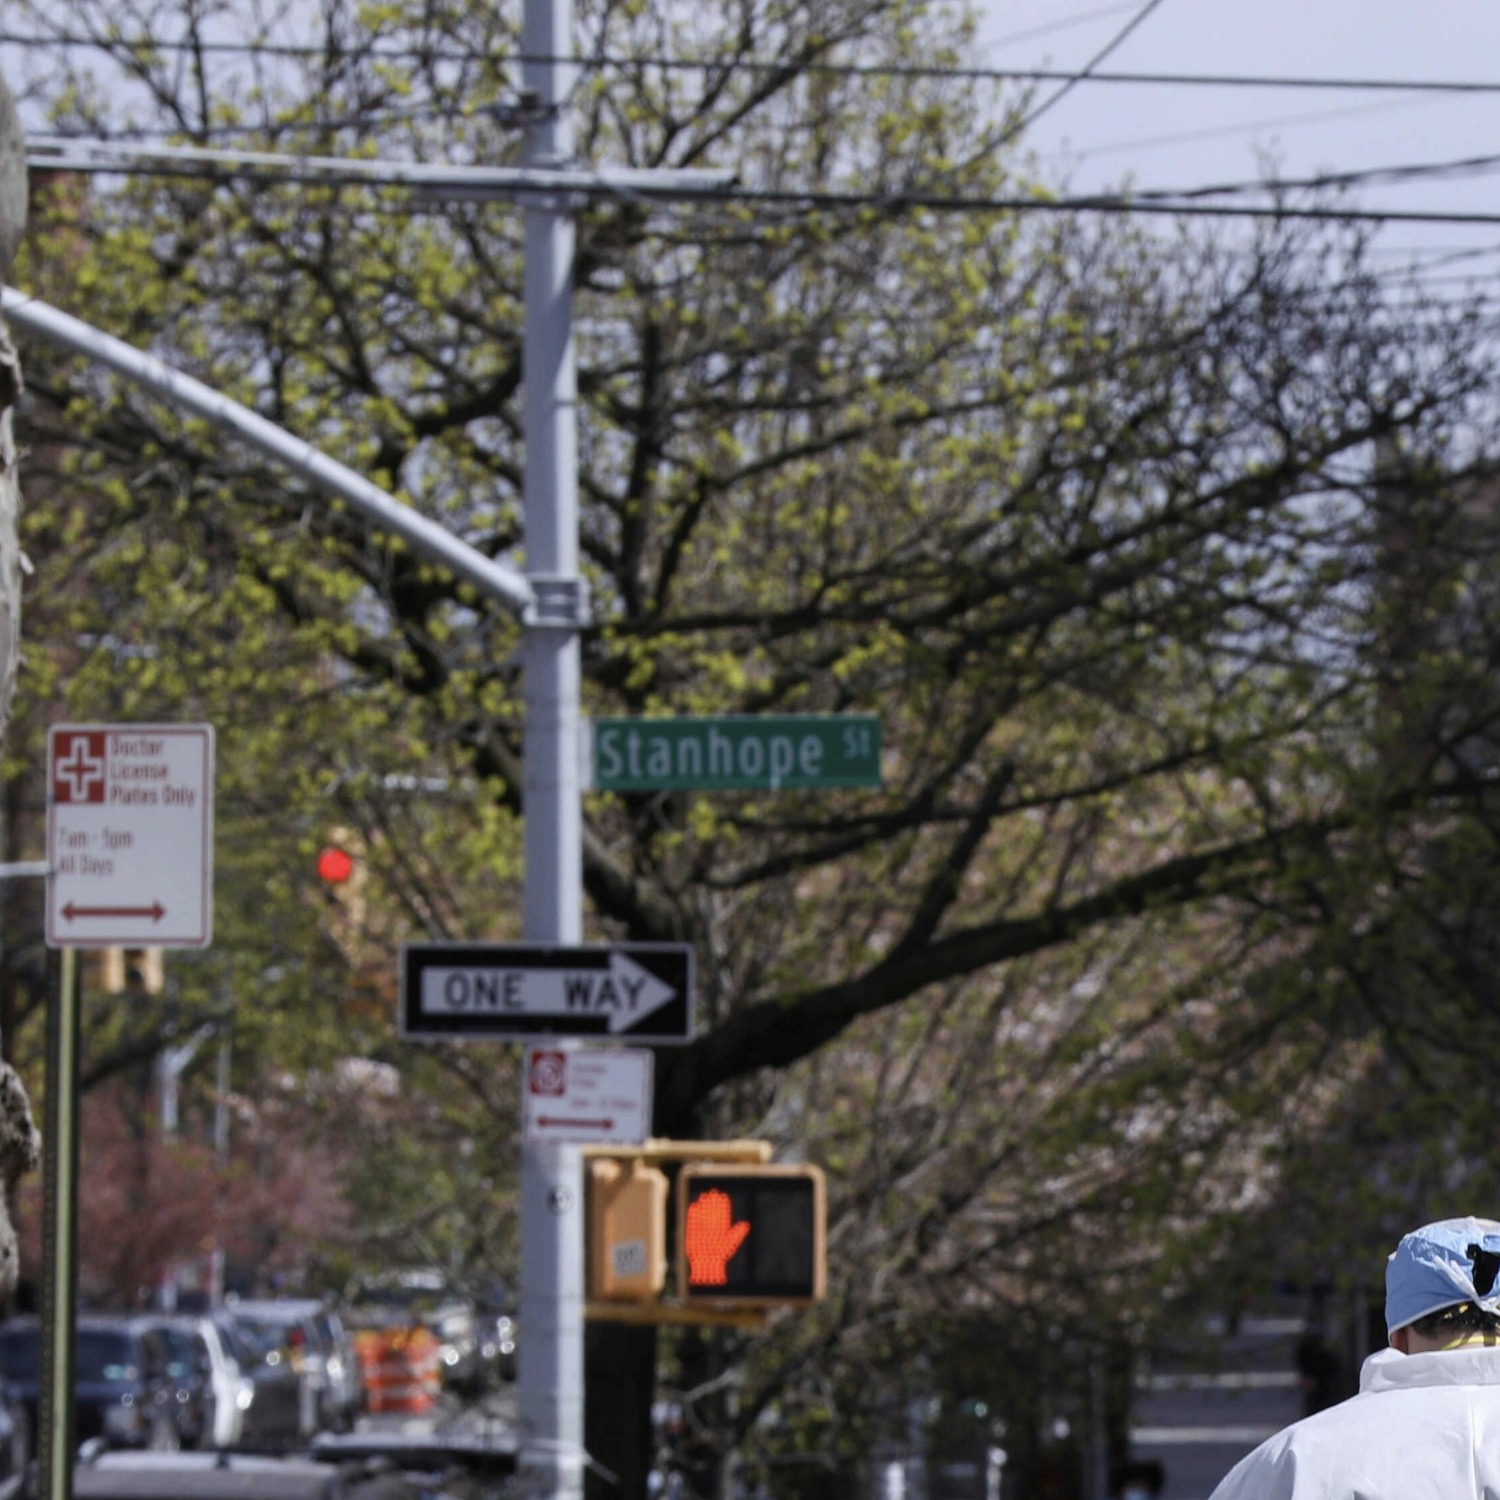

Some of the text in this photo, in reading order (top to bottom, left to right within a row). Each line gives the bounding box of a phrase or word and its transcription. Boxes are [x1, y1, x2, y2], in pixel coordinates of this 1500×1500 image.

[601, 725, 823, 788] Stanhope
[110, 761, 168, 780] License
[110, 785, 195, 808] Plates Only
[80, 857, 114, 877] Days
[443, 973, 647, 1009] ONE WAY
